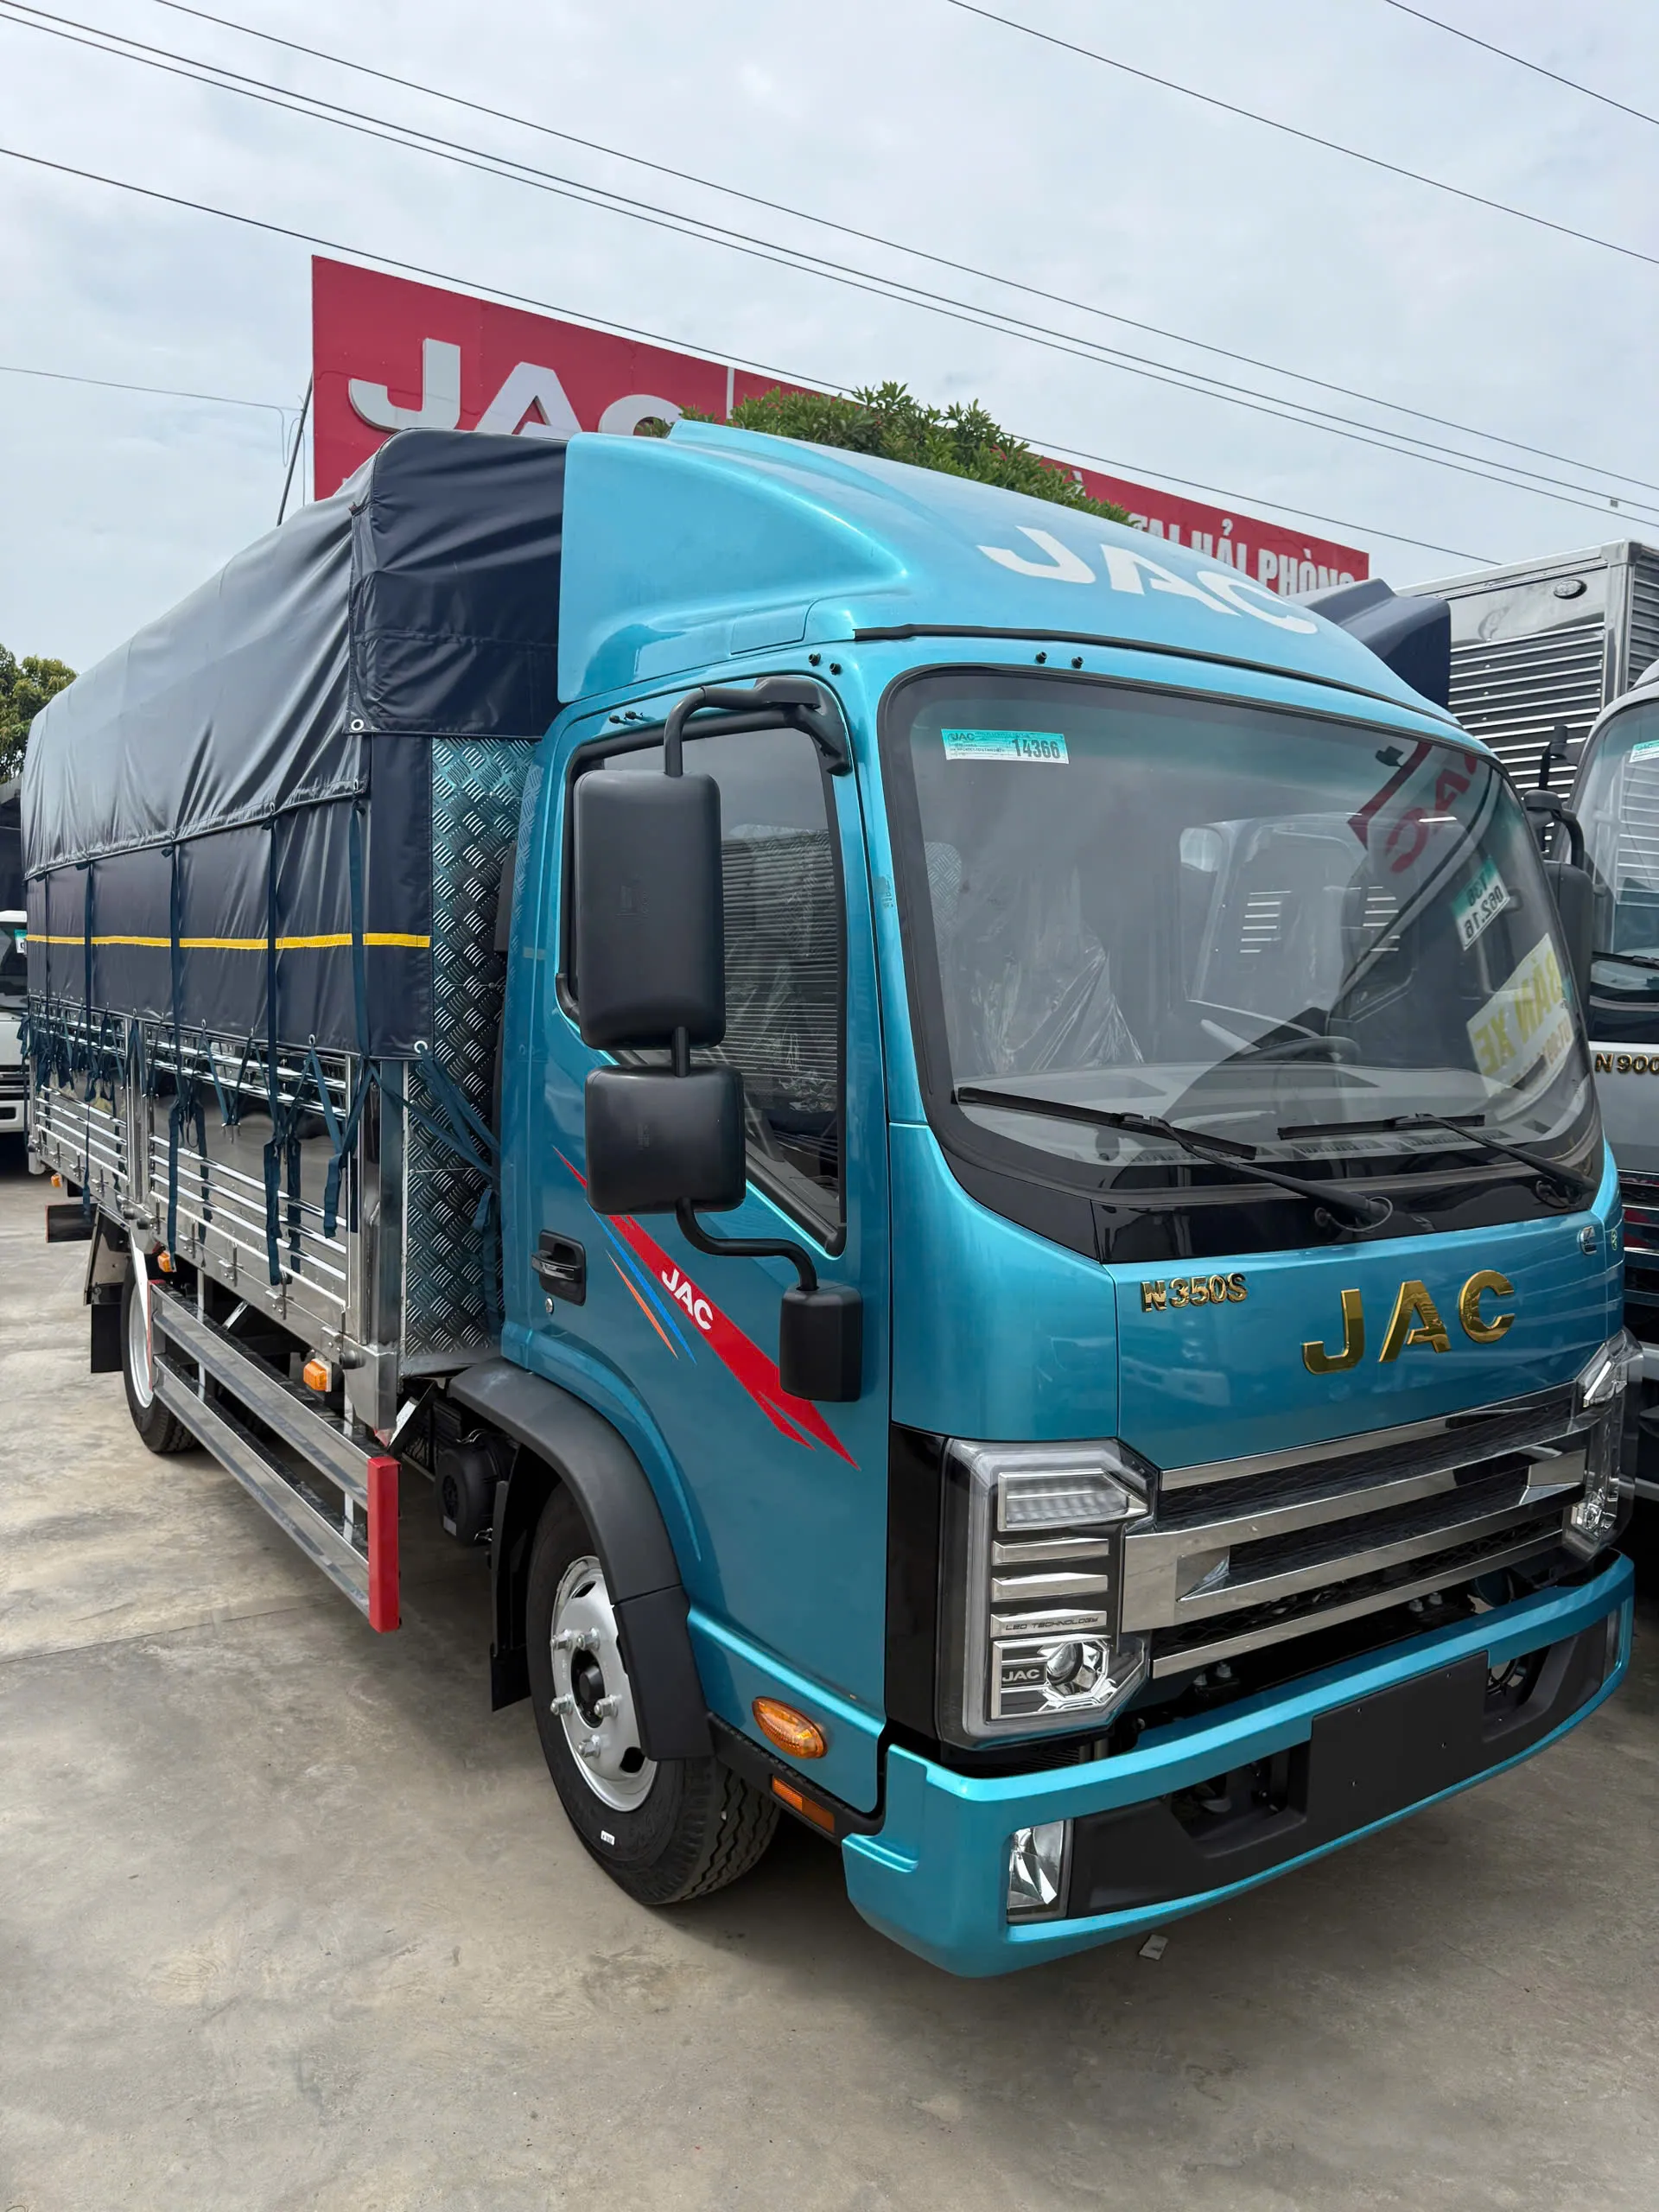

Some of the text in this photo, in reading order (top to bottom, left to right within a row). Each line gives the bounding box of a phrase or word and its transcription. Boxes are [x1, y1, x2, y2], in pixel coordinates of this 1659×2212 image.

[977, 525, 1319, 634] JAC
[1012, 738, 1061, 759] 14366
[662, 1268, 714, 1330] JAC
[1141, 1273, 1249, 1313] N350S
[1302, 1269, 1516, 1375] JAC
[1005, 1616, 1099, 1631] LED TECHNOLOGY
[1002, 1669, 1040, 1681] JAC
